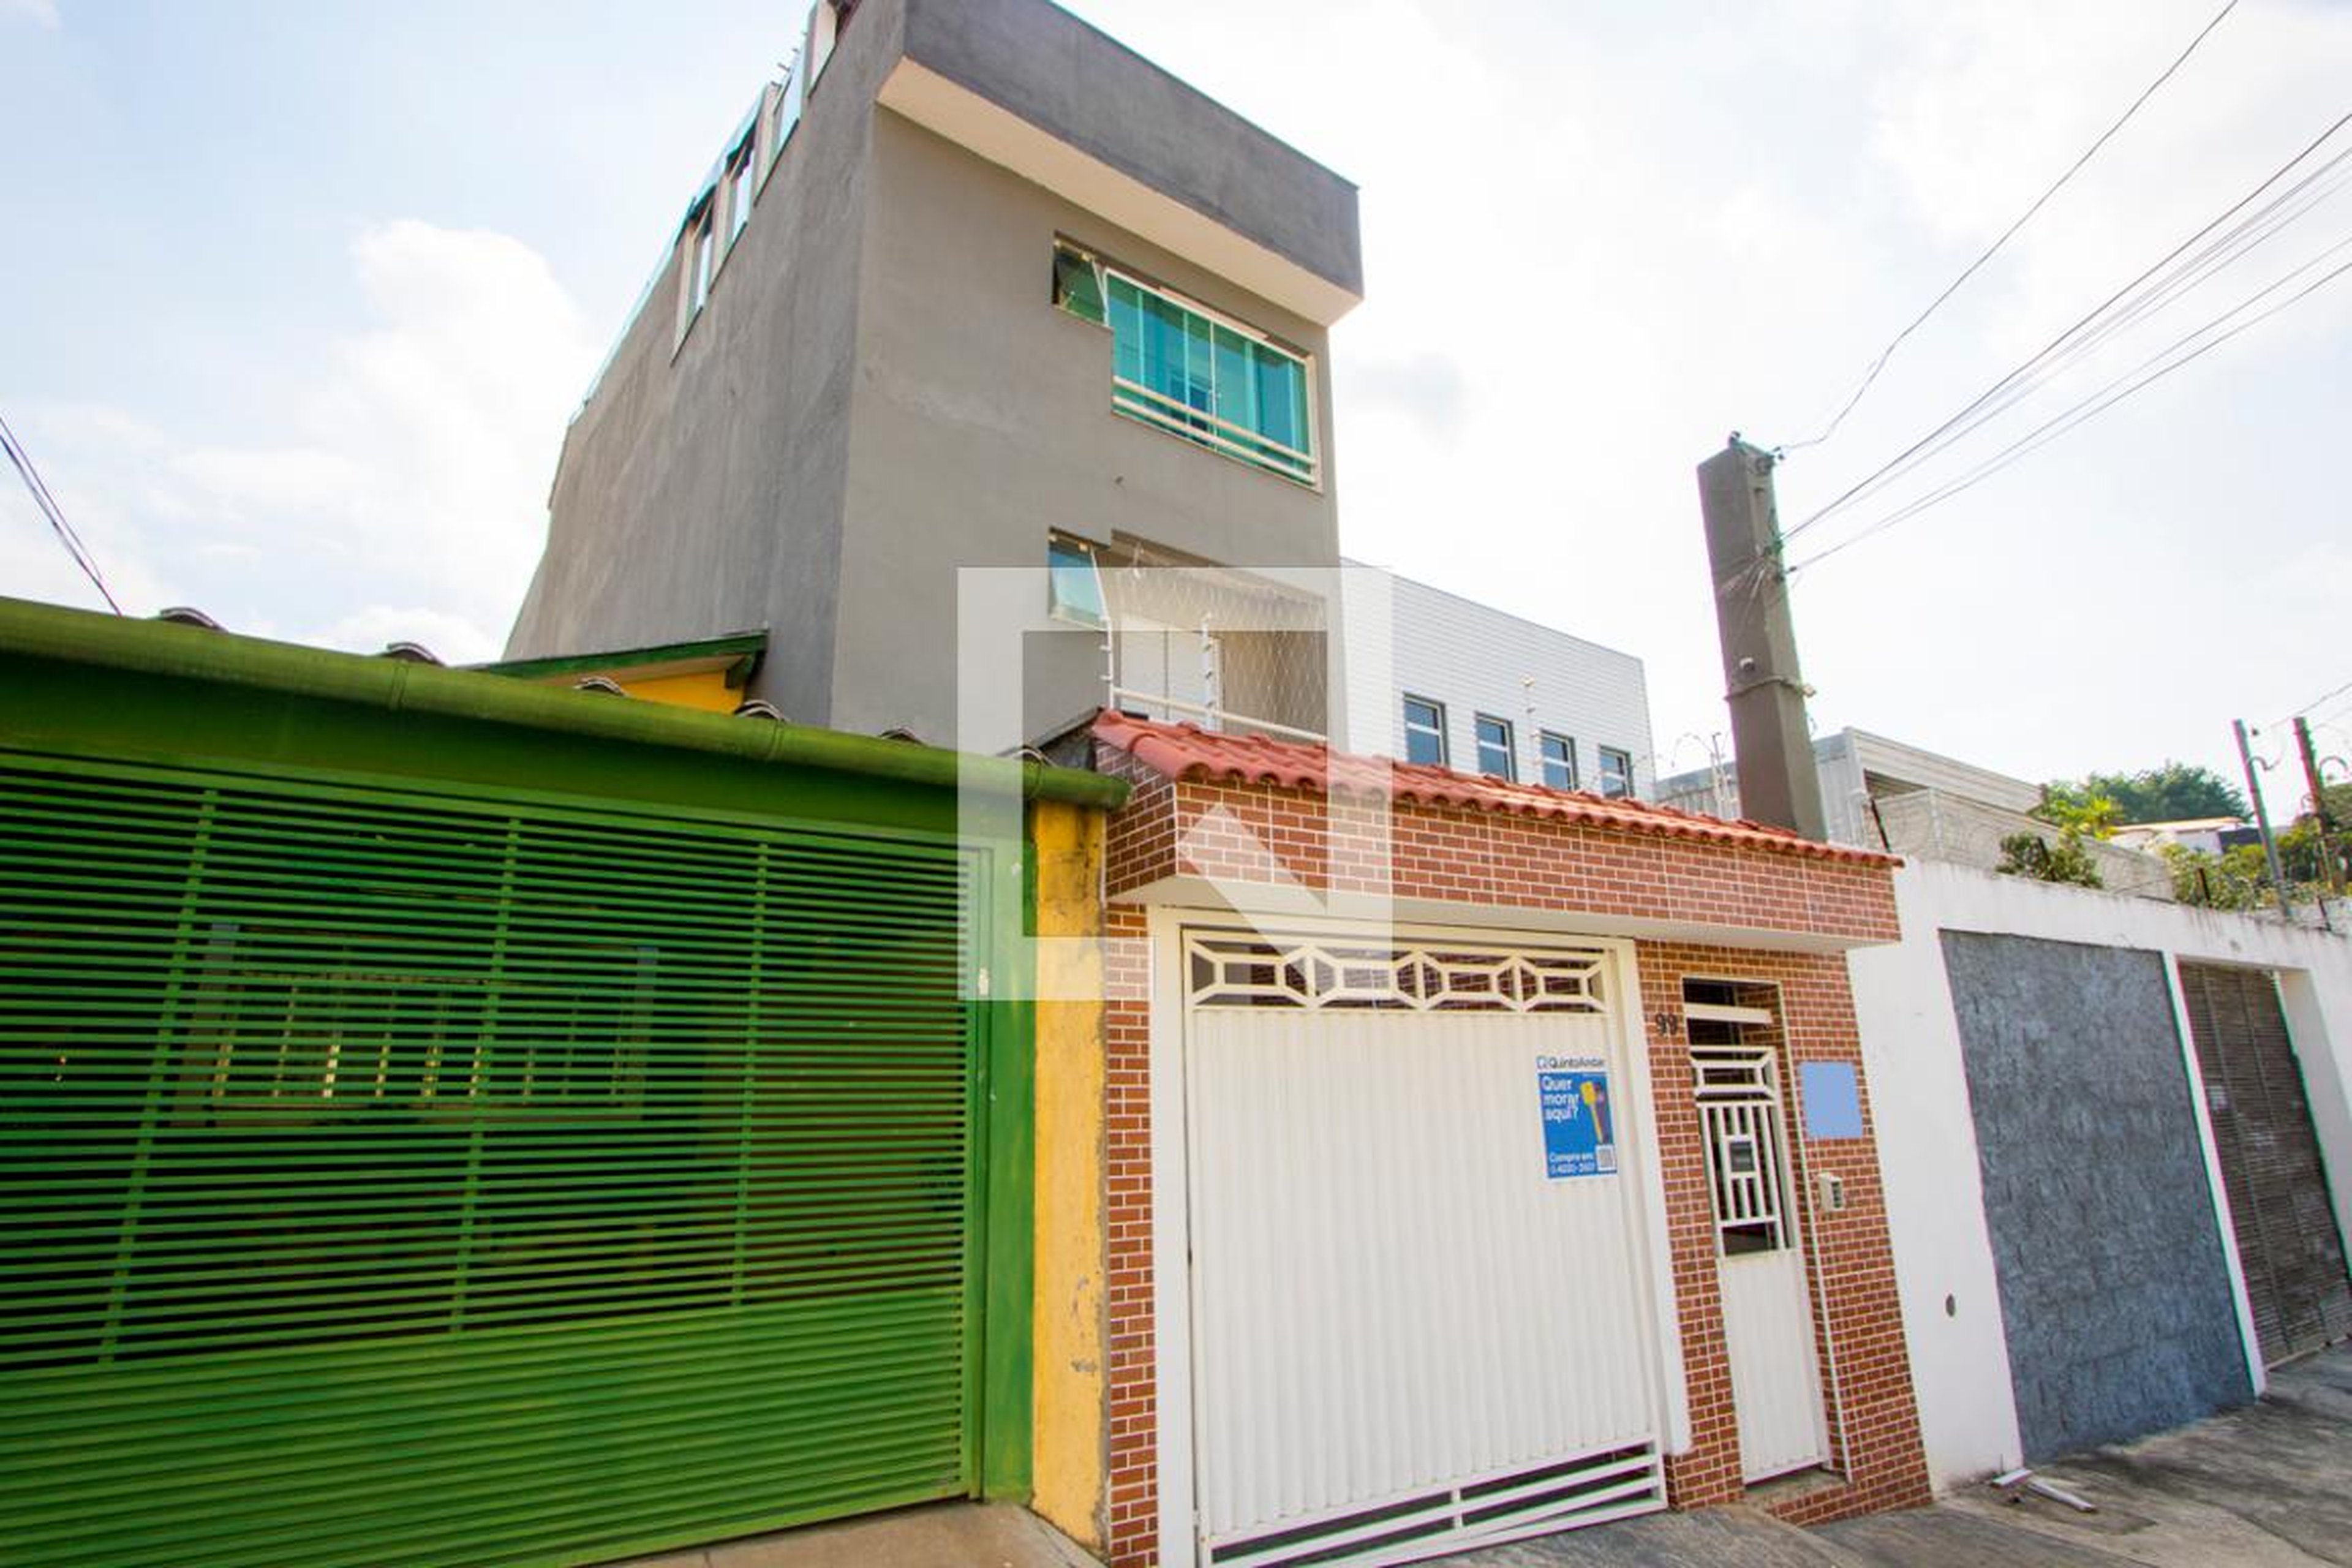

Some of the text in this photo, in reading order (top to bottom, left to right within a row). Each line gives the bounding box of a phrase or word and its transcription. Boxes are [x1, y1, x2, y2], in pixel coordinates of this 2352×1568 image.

[1541, 1076, 1572, 1091] Quer
[1543, 1093, 1579, 1105] morar
[1545, 1104, 1579, 1123] aqui?
